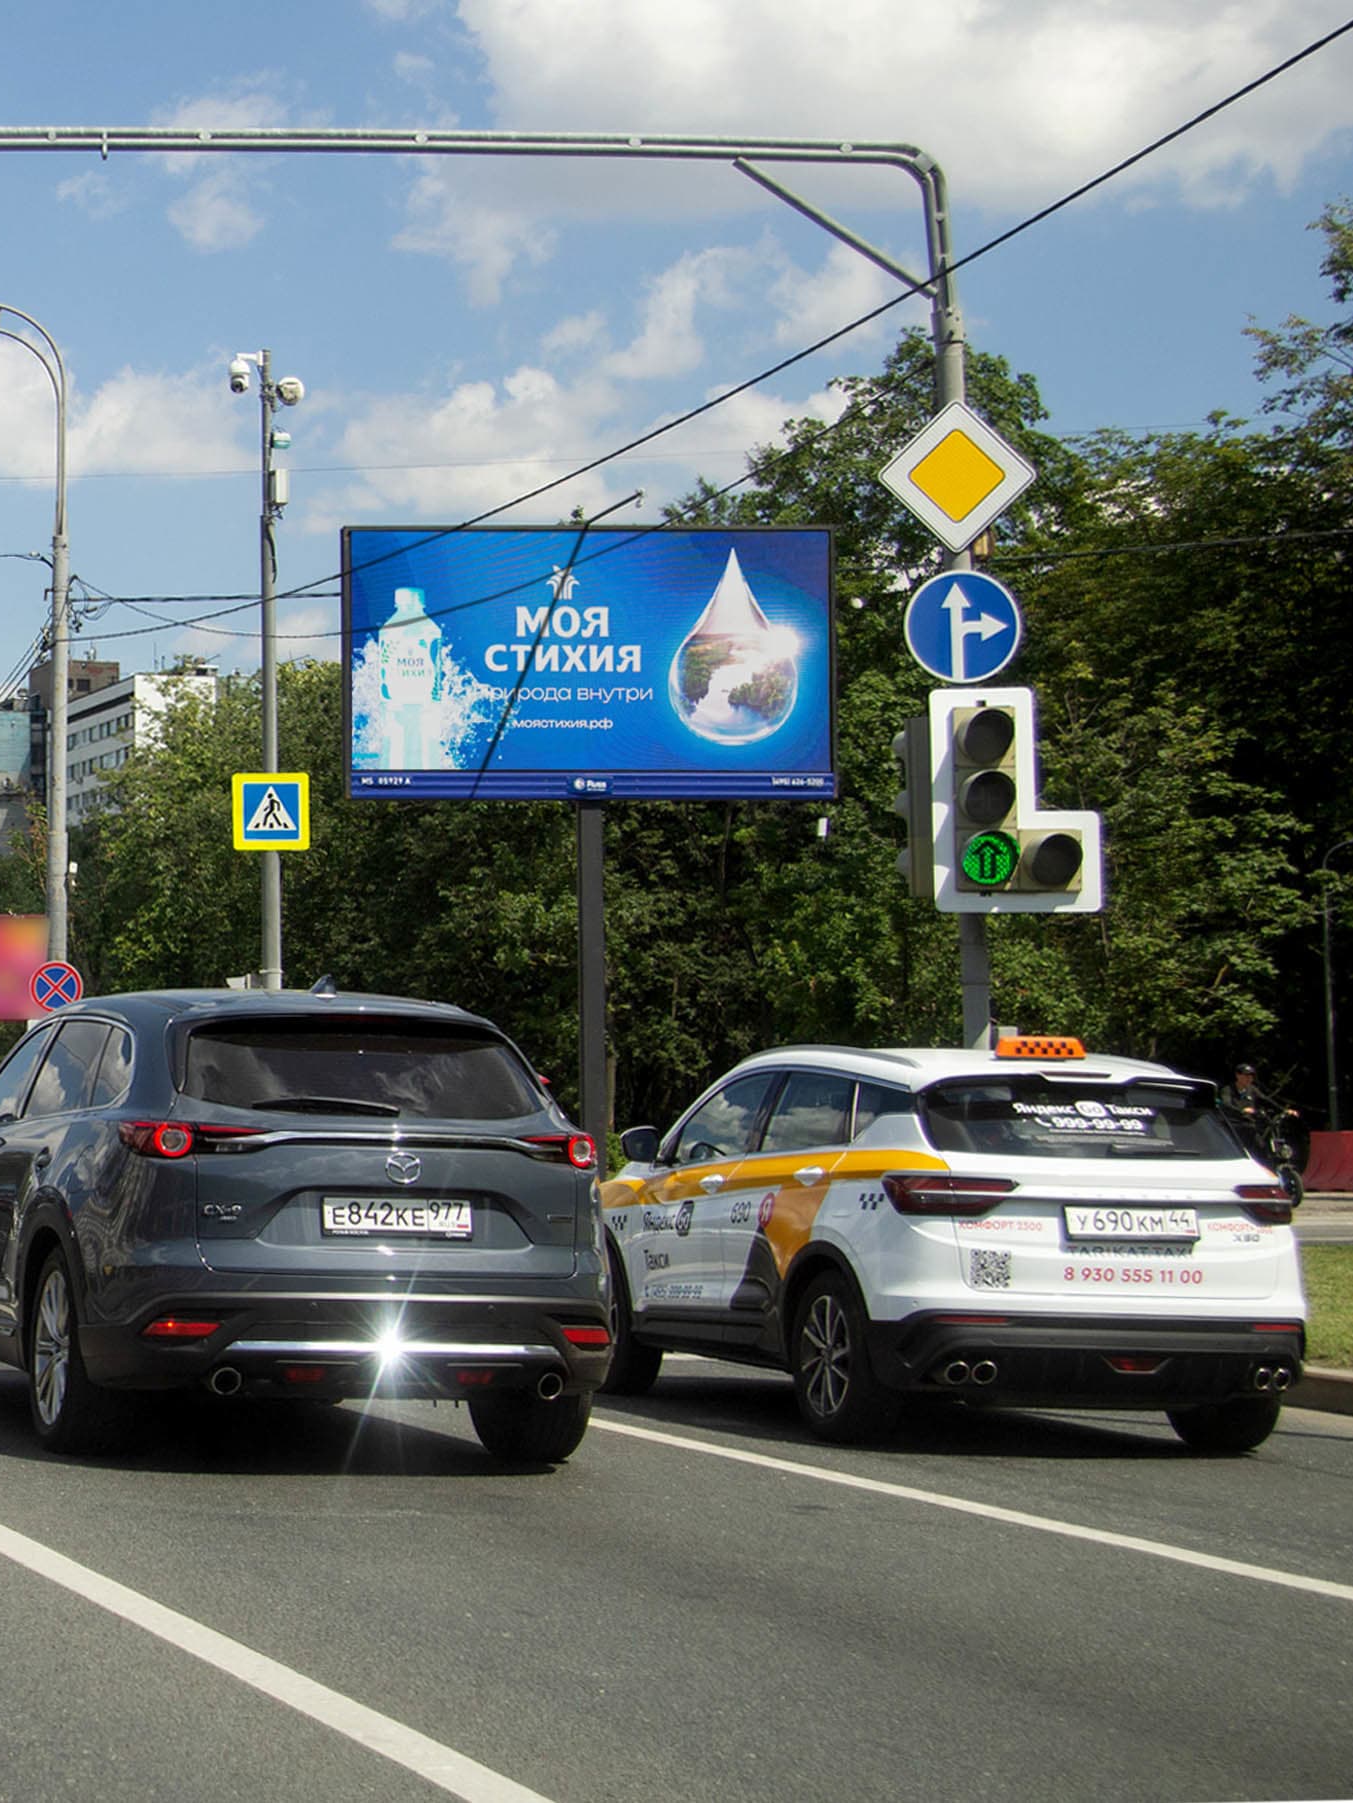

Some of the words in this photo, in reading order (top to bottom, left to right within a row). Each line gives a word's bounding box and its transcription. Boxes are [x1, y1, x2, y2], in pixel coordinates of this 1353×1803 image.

[515, 605, 610, 638] МОЯ
[484, 643, 642, 673] СТИХИЯ
[577, 687, 654, 704] внутри
[512, 717, 614, 730] моястихия.рф
[1012, 1101, 1077, 1115] Яндекс
[1105, 1104, 1154, 1116] Такси
[1052, 1116, 1145, 1131] 999-99-99
[204, 1204, 242, 1216] CX-9
[332, 1201, 425, 1226] Е842КЕ
[430, 1201, 465, 1221] 977
[730, 1201, 751, 1224] 690
[958, 1220, 1014, 1230] КОМФОРТ
[1076, 1210, 1164, 1233] У690КМ
[1169, 1211, 1190, 1227] 44
[643, 1249, 669, 1270] Такси
[1064, 1266, 1074, 1281] 8
[1081, 1267, 1115, 1283] 930
[1121, 1268, 1153, 1283] 555
[1160, 1270, 1174, 1283] 11
[1180, 1270, 1203, 1284] 00
